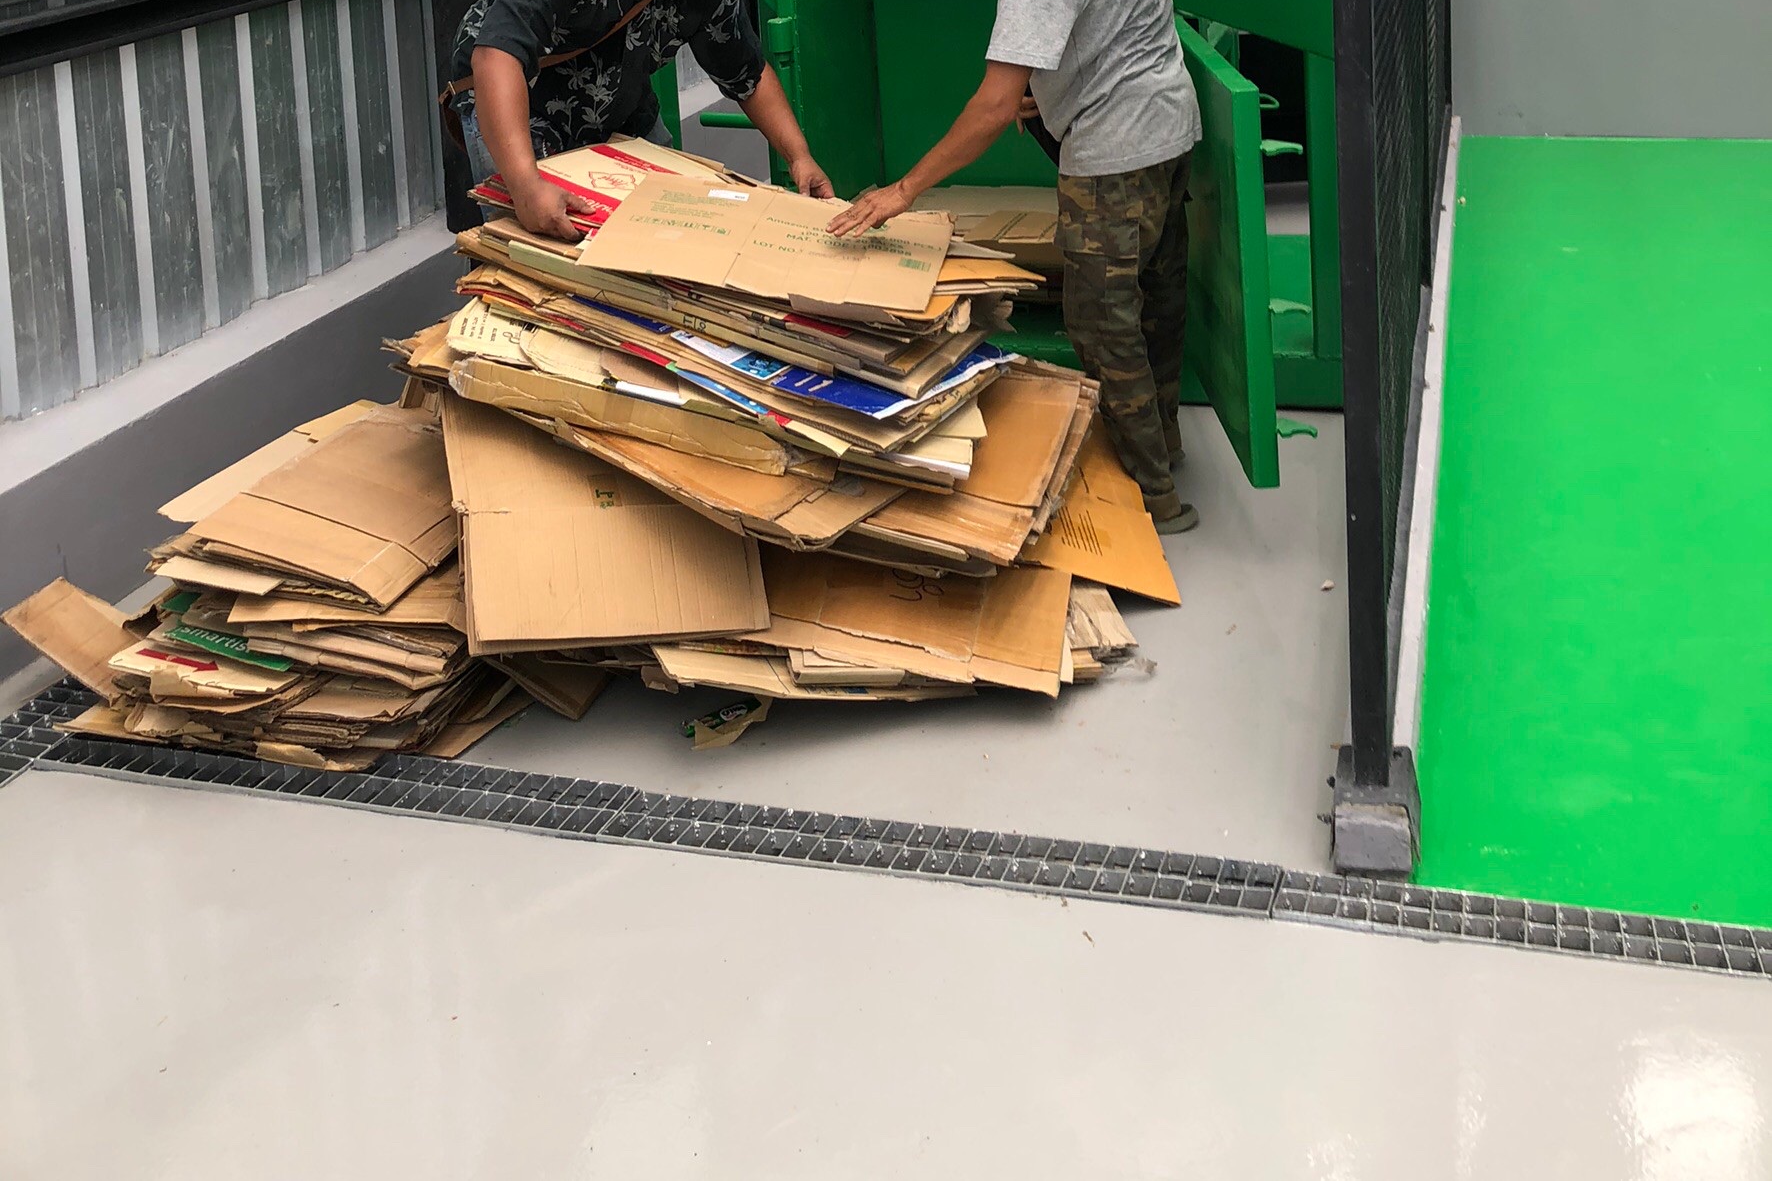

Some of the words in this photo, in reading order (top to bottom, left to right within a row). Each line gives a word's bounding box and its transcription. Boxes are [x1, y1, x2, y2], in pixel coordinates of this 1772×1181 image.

[766, 216, 808, 230] Amazon
[752, 239, 774, 249] LOT
[816, 238, 849, 249] CODE
[180, 625, 250, 654] smartis
